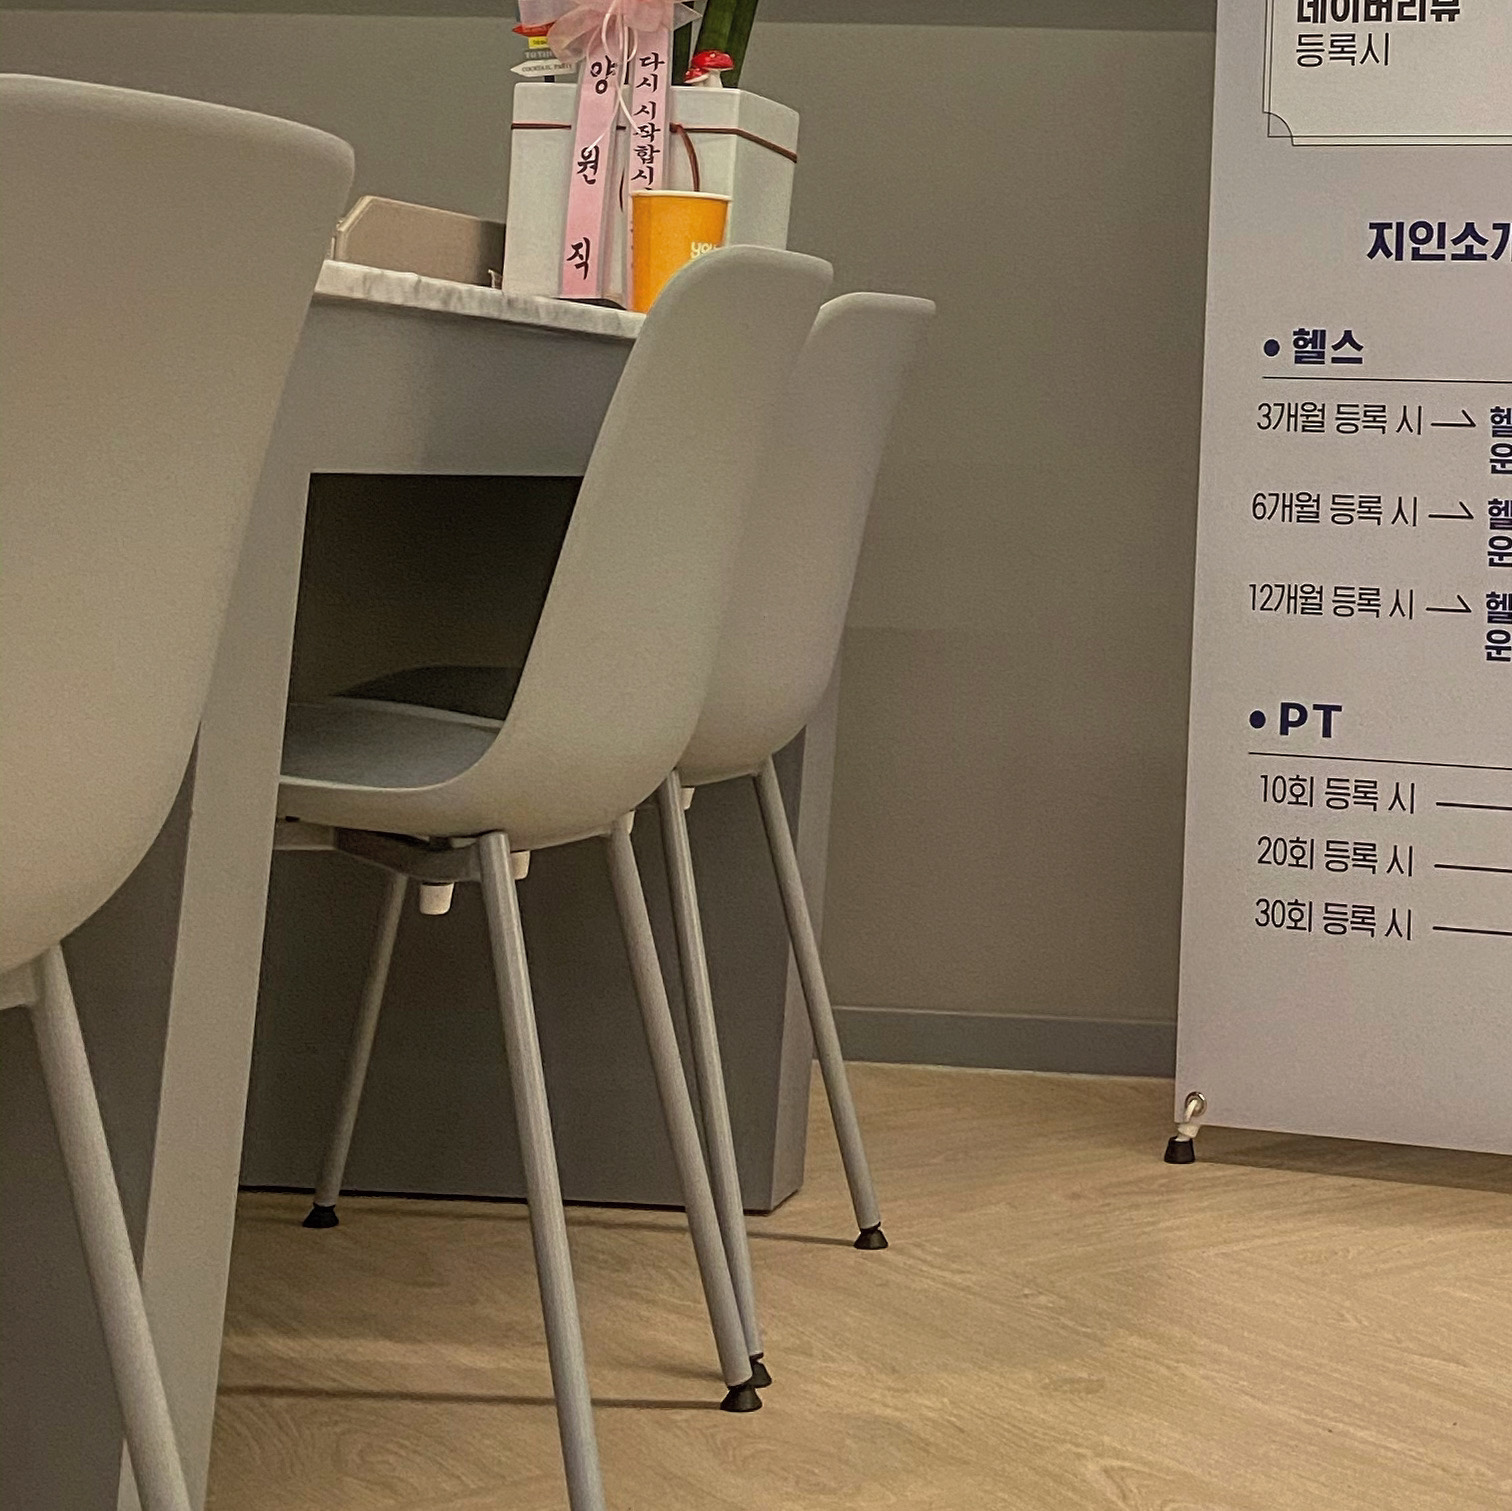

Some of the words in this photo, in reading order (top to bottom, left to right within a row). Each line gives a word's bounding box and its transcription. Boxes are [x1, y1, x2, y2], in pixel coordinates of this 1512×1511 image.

[1296, 33, 1389, 67] 등록시
[636, 52, 665, 93] 다시
[631, 101, 662, 191] 시작합시
[1293, 328, 1363, 364] 헬스
[1257, 402, 1325, 432] 3개월
[1335, 404, 1387, 434] 등록
[1396, 406, 1421, 435] 시
[1253, 492, 1320, 523] 6개월
[1330, 495, 1382, 525] 등록
[1391, 497, 1417, 526] 시
[1249, 584, 1323, 615] 12개월
[1332, 586, 1381, 618] 등록
[1389, 589, 1413, 620] 시
[1280, 702, 1342, 738] PT
[1261, 775, 1314, 807] 10회
[1325, 778, 1378, 811] 등록
[1388, 782, 1414, 814] 시
[1258, 836, 1314, 870] 20회
[1324, 840, 1377, 874] 등록
[1387, 845, 1412, 877] 시
[1255, 899, 1312, 932] 30회
[1323, 903, 1376, 938] 등록
[1385, 908, 1411, 940] 시
